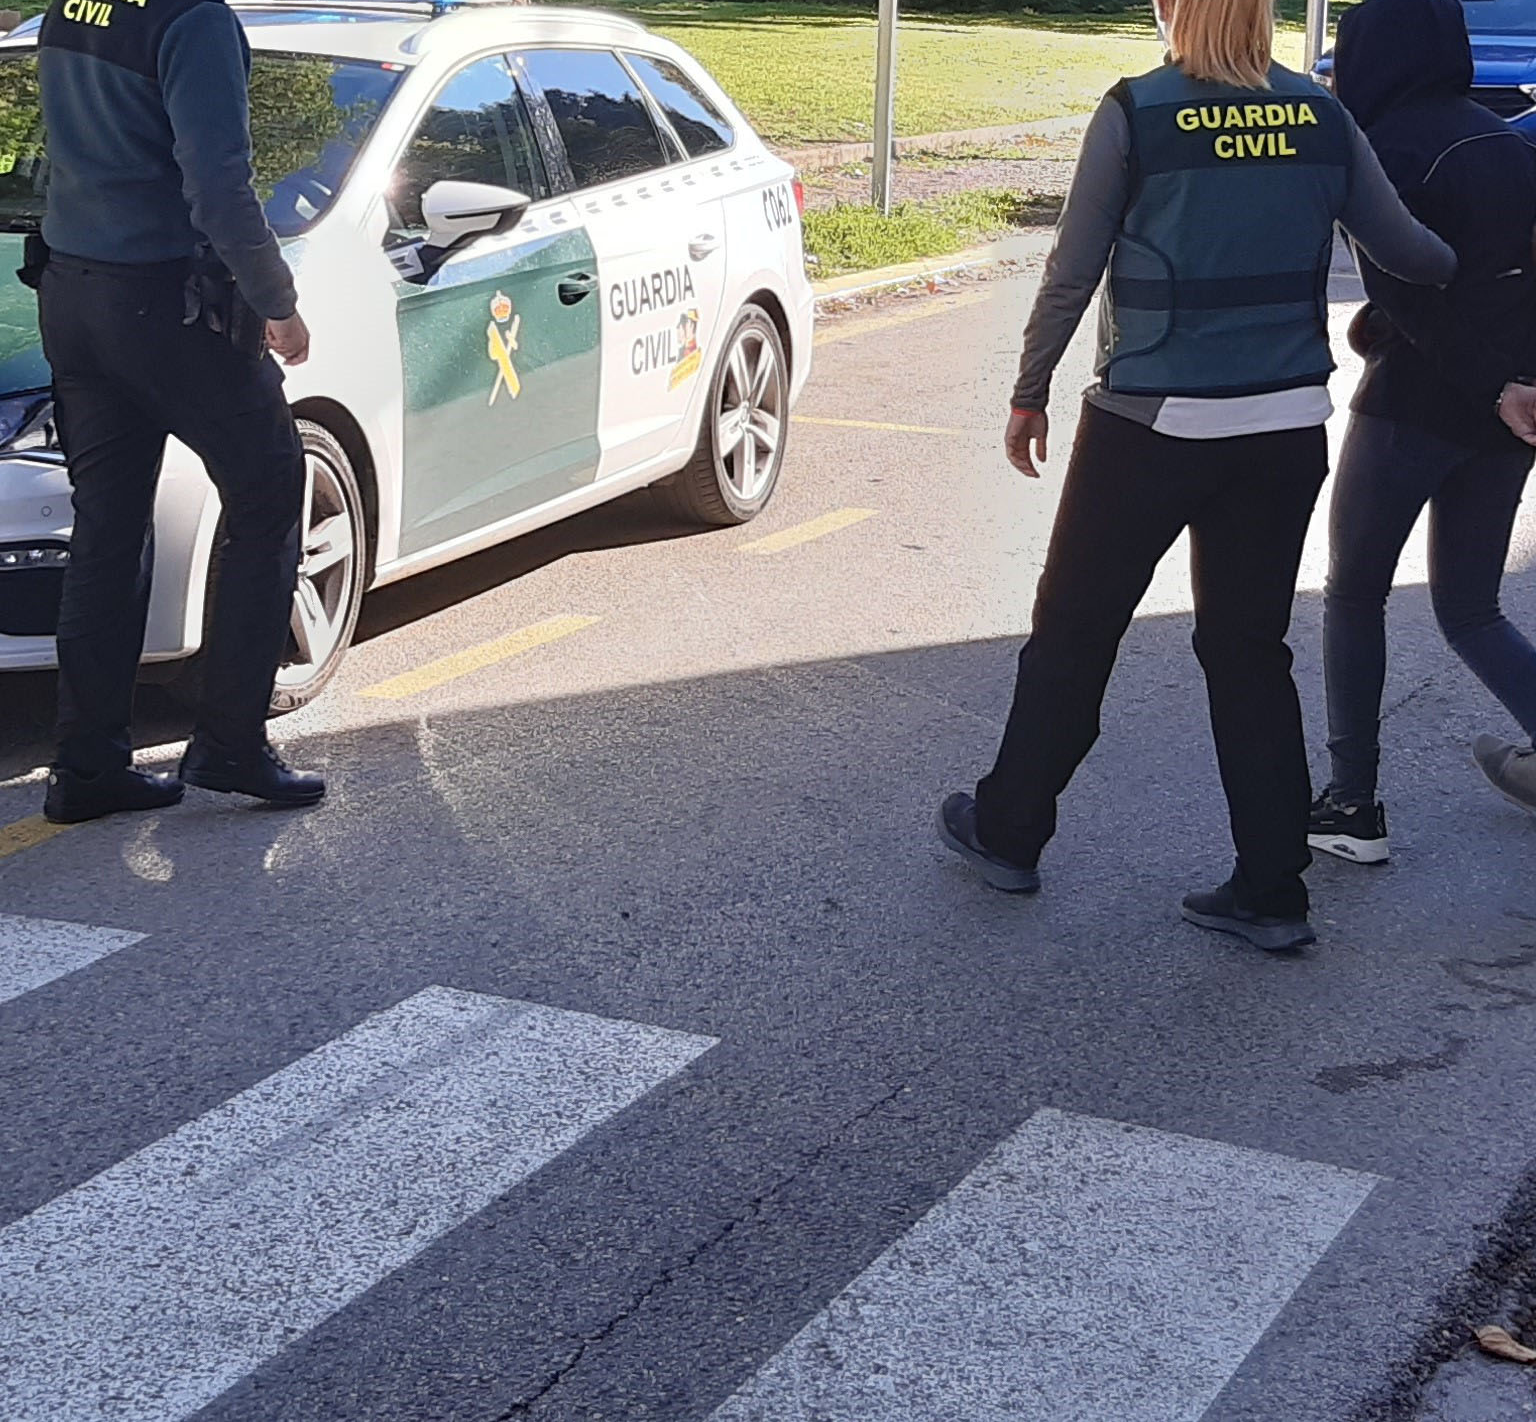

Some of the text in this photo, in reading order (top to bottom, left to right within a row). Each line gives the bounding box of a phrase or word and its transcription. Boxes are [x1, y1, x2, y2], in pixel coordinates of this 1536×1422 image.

[1176, 103, 1318, 131] GUARDIA
[1215, 132, 1297, 159] CIVIL
[610, 264, 695, 320] GUARDIA
[631, 328, 677, 375] CIVIL
